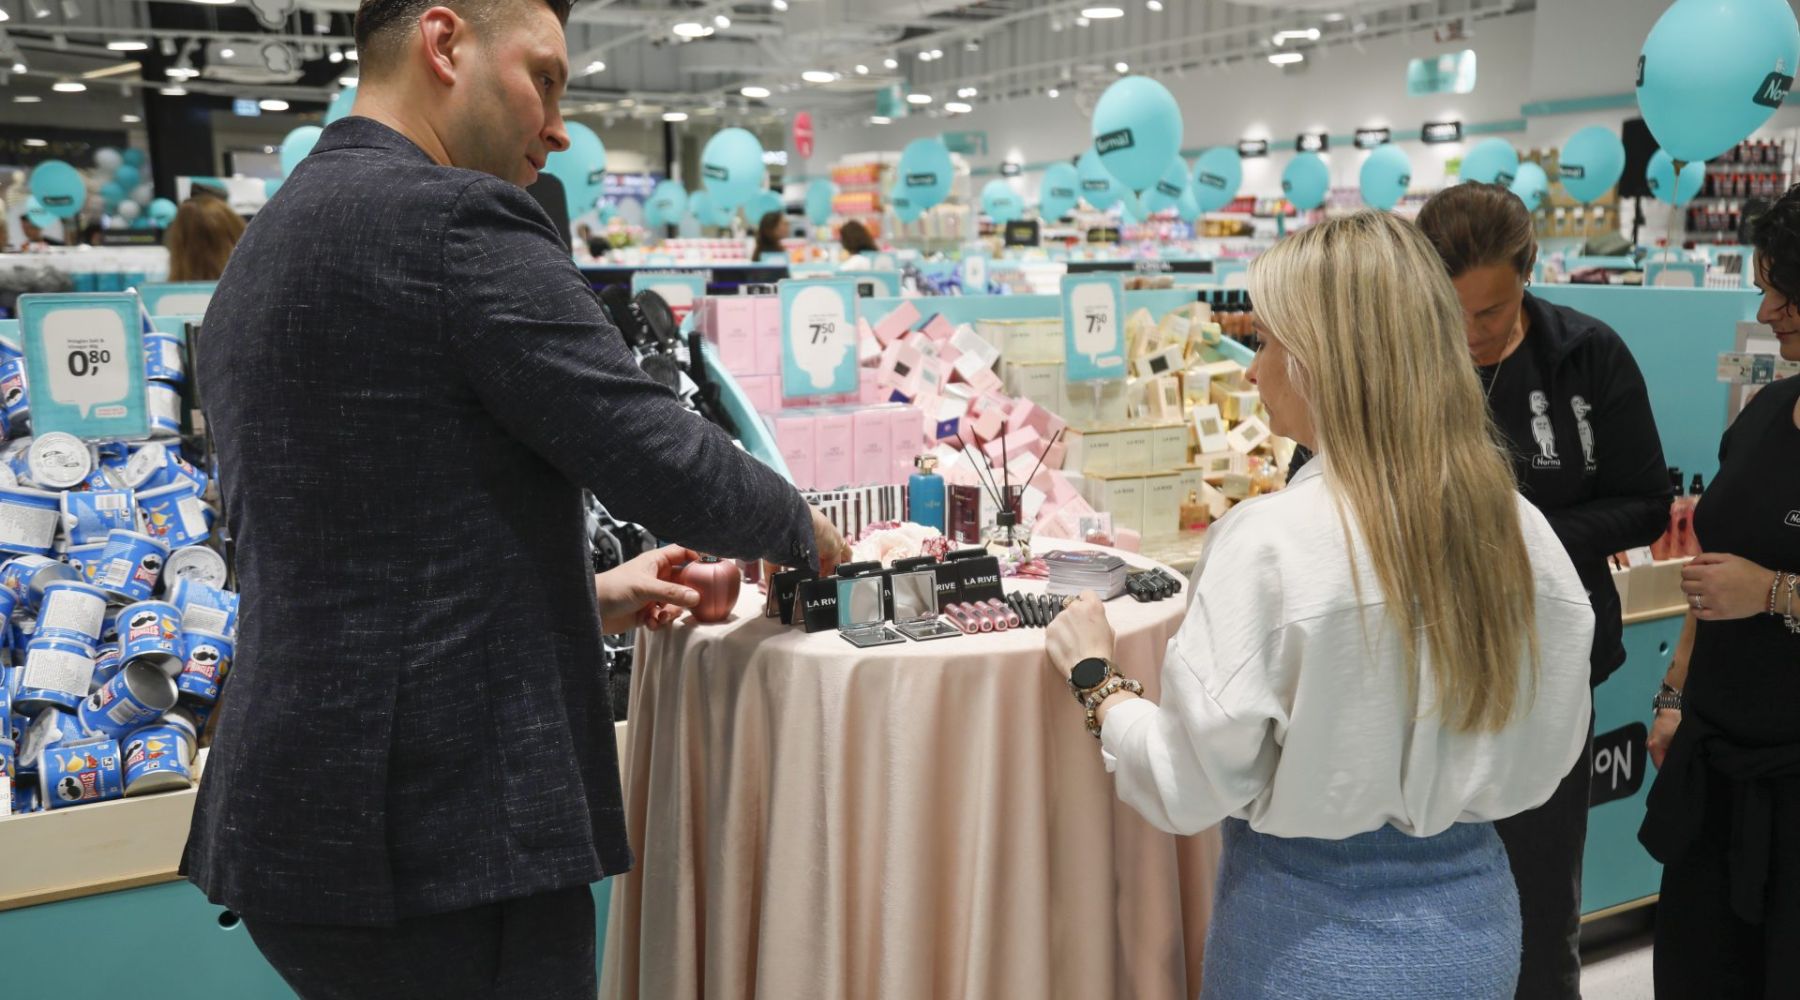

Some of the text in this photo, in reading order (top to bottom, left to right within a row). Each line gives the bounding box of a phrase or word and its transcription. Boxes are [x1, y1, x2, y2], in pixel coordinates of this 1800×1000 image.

[809, 322, 835, 344] 7,50
[1086, 313, 1107, 333] 7,50
[68, 350, 110, 376] 0,80
[964, 574, 999, 586] LA RIVE
[806, 597, 837, 608] LA RIV
